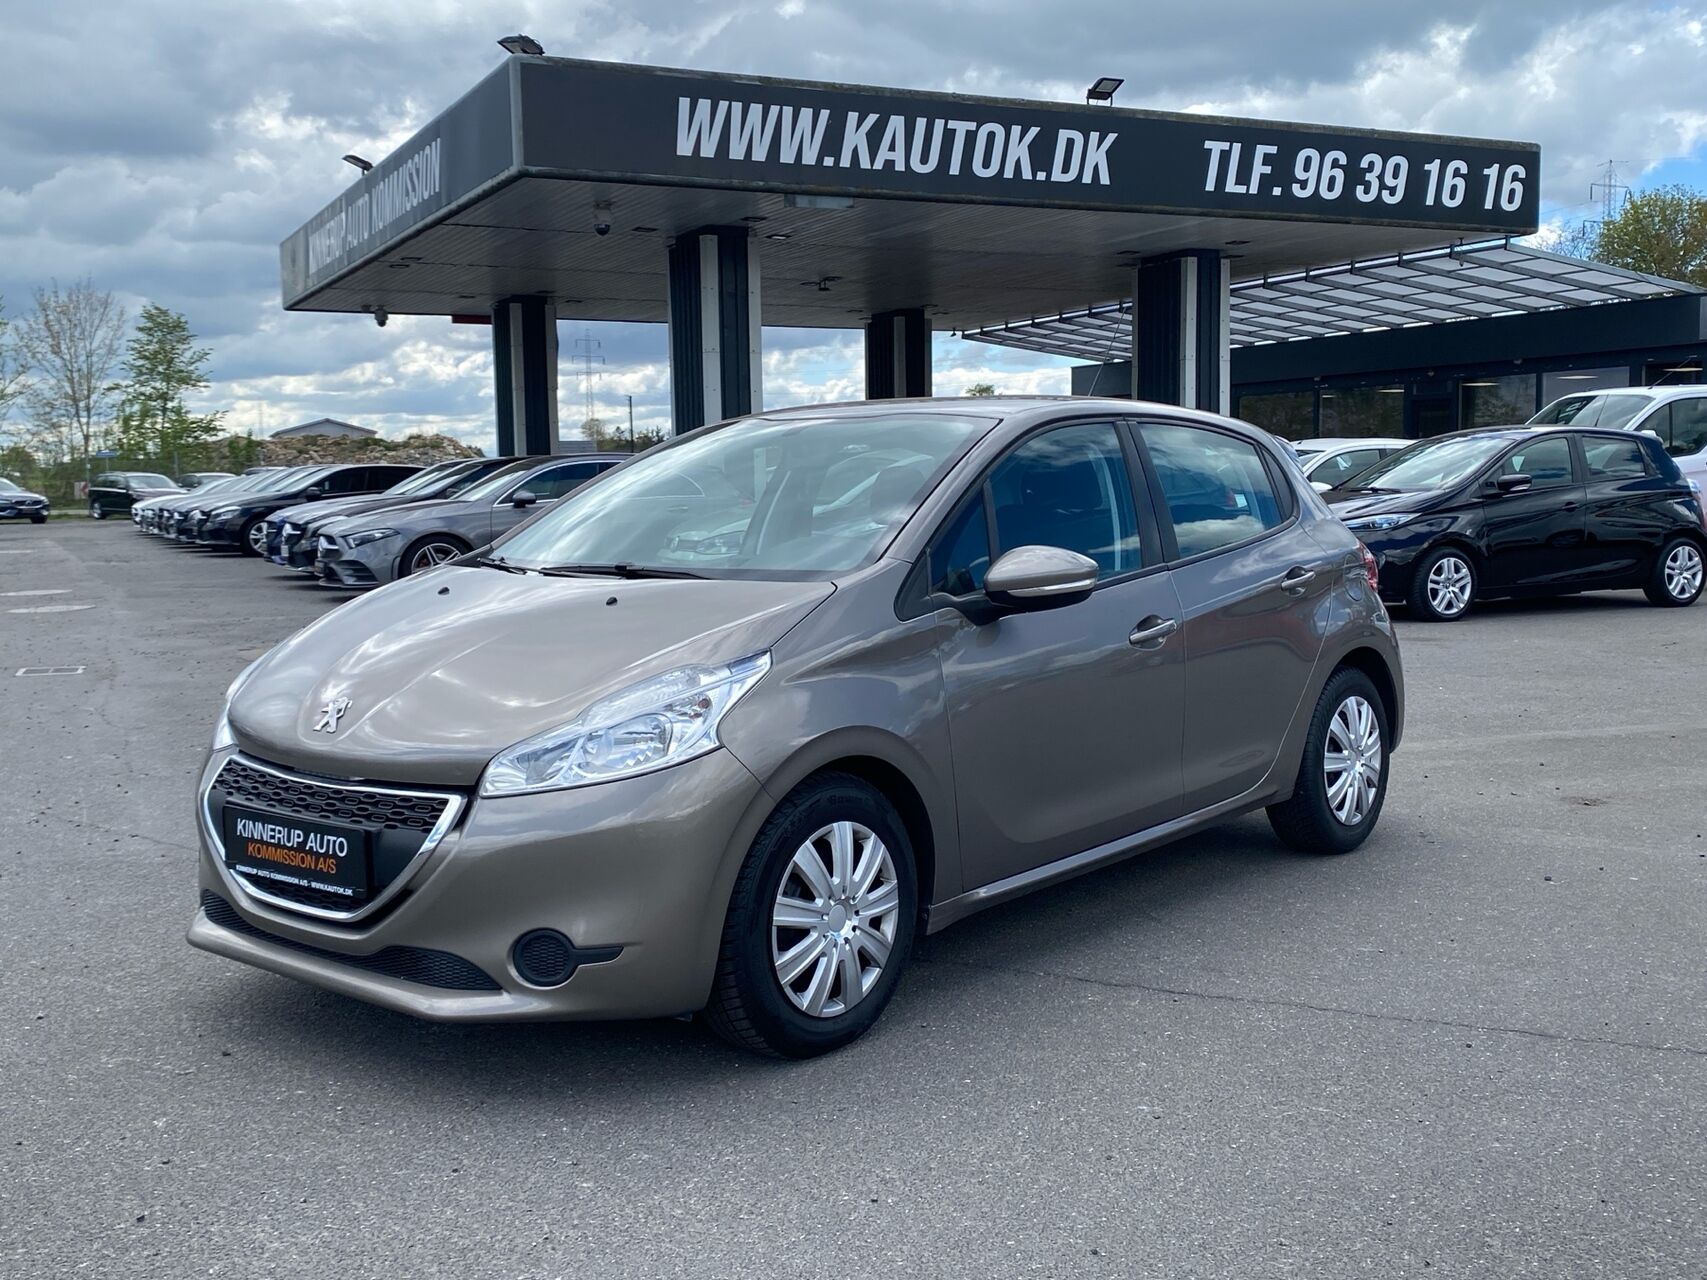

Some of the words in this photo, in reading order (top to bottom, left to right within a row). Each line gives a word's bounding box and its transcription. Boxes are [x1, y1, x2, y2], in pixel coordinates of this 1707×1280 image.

[676, 97, 1119, 186] WWW.KAUTOK.DK
[1203, 140, 1281, 196] TLF.
[1291, 148, 1347, 200] 96
[1355, 153, 1409, 204] 39
[1424, 158, 1468, 208] 16
[1482, 163, 1527, 212] 16
[346, 193, 369, 251] AUTO
[372, 137, 441, 235] KOMMISSION
[237, 818, 303, 847] KINNERUP
[305, 832, 348, 858] AUTO
[247, 841, 315, 870] KOMMISSION
[316, 856, 337, 875] A/S
